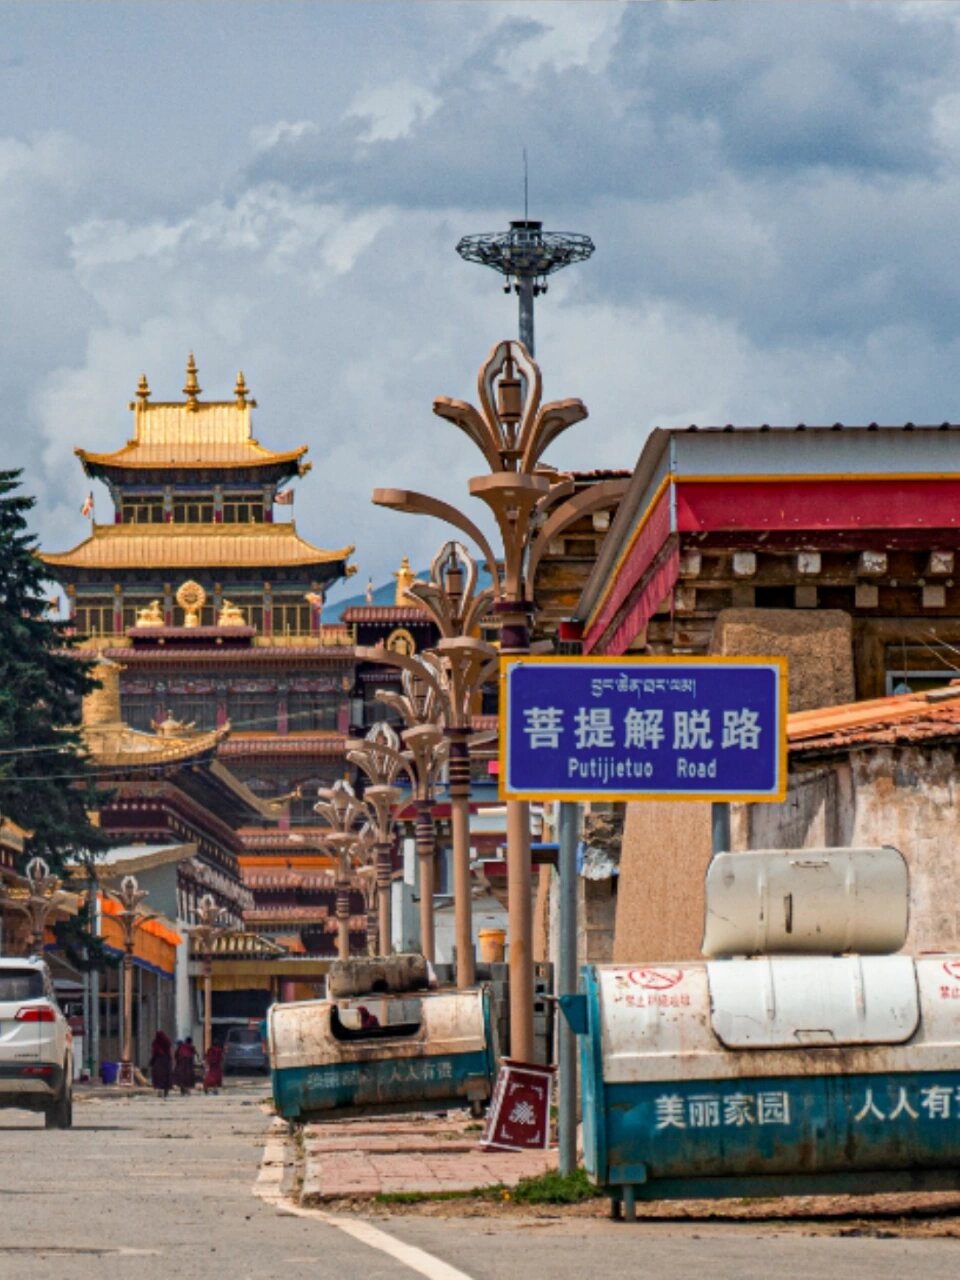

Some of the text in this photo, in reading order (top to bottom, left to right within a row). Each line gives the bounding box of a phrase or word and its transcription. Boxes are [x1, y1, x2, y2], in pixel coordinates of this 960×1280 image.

[523, 707, 762, 750] 菩提解脱路
[568, 757, 717, 783] Putijietuo Road
[654, 1084, 960, 1130] 美丽家园 人人有
